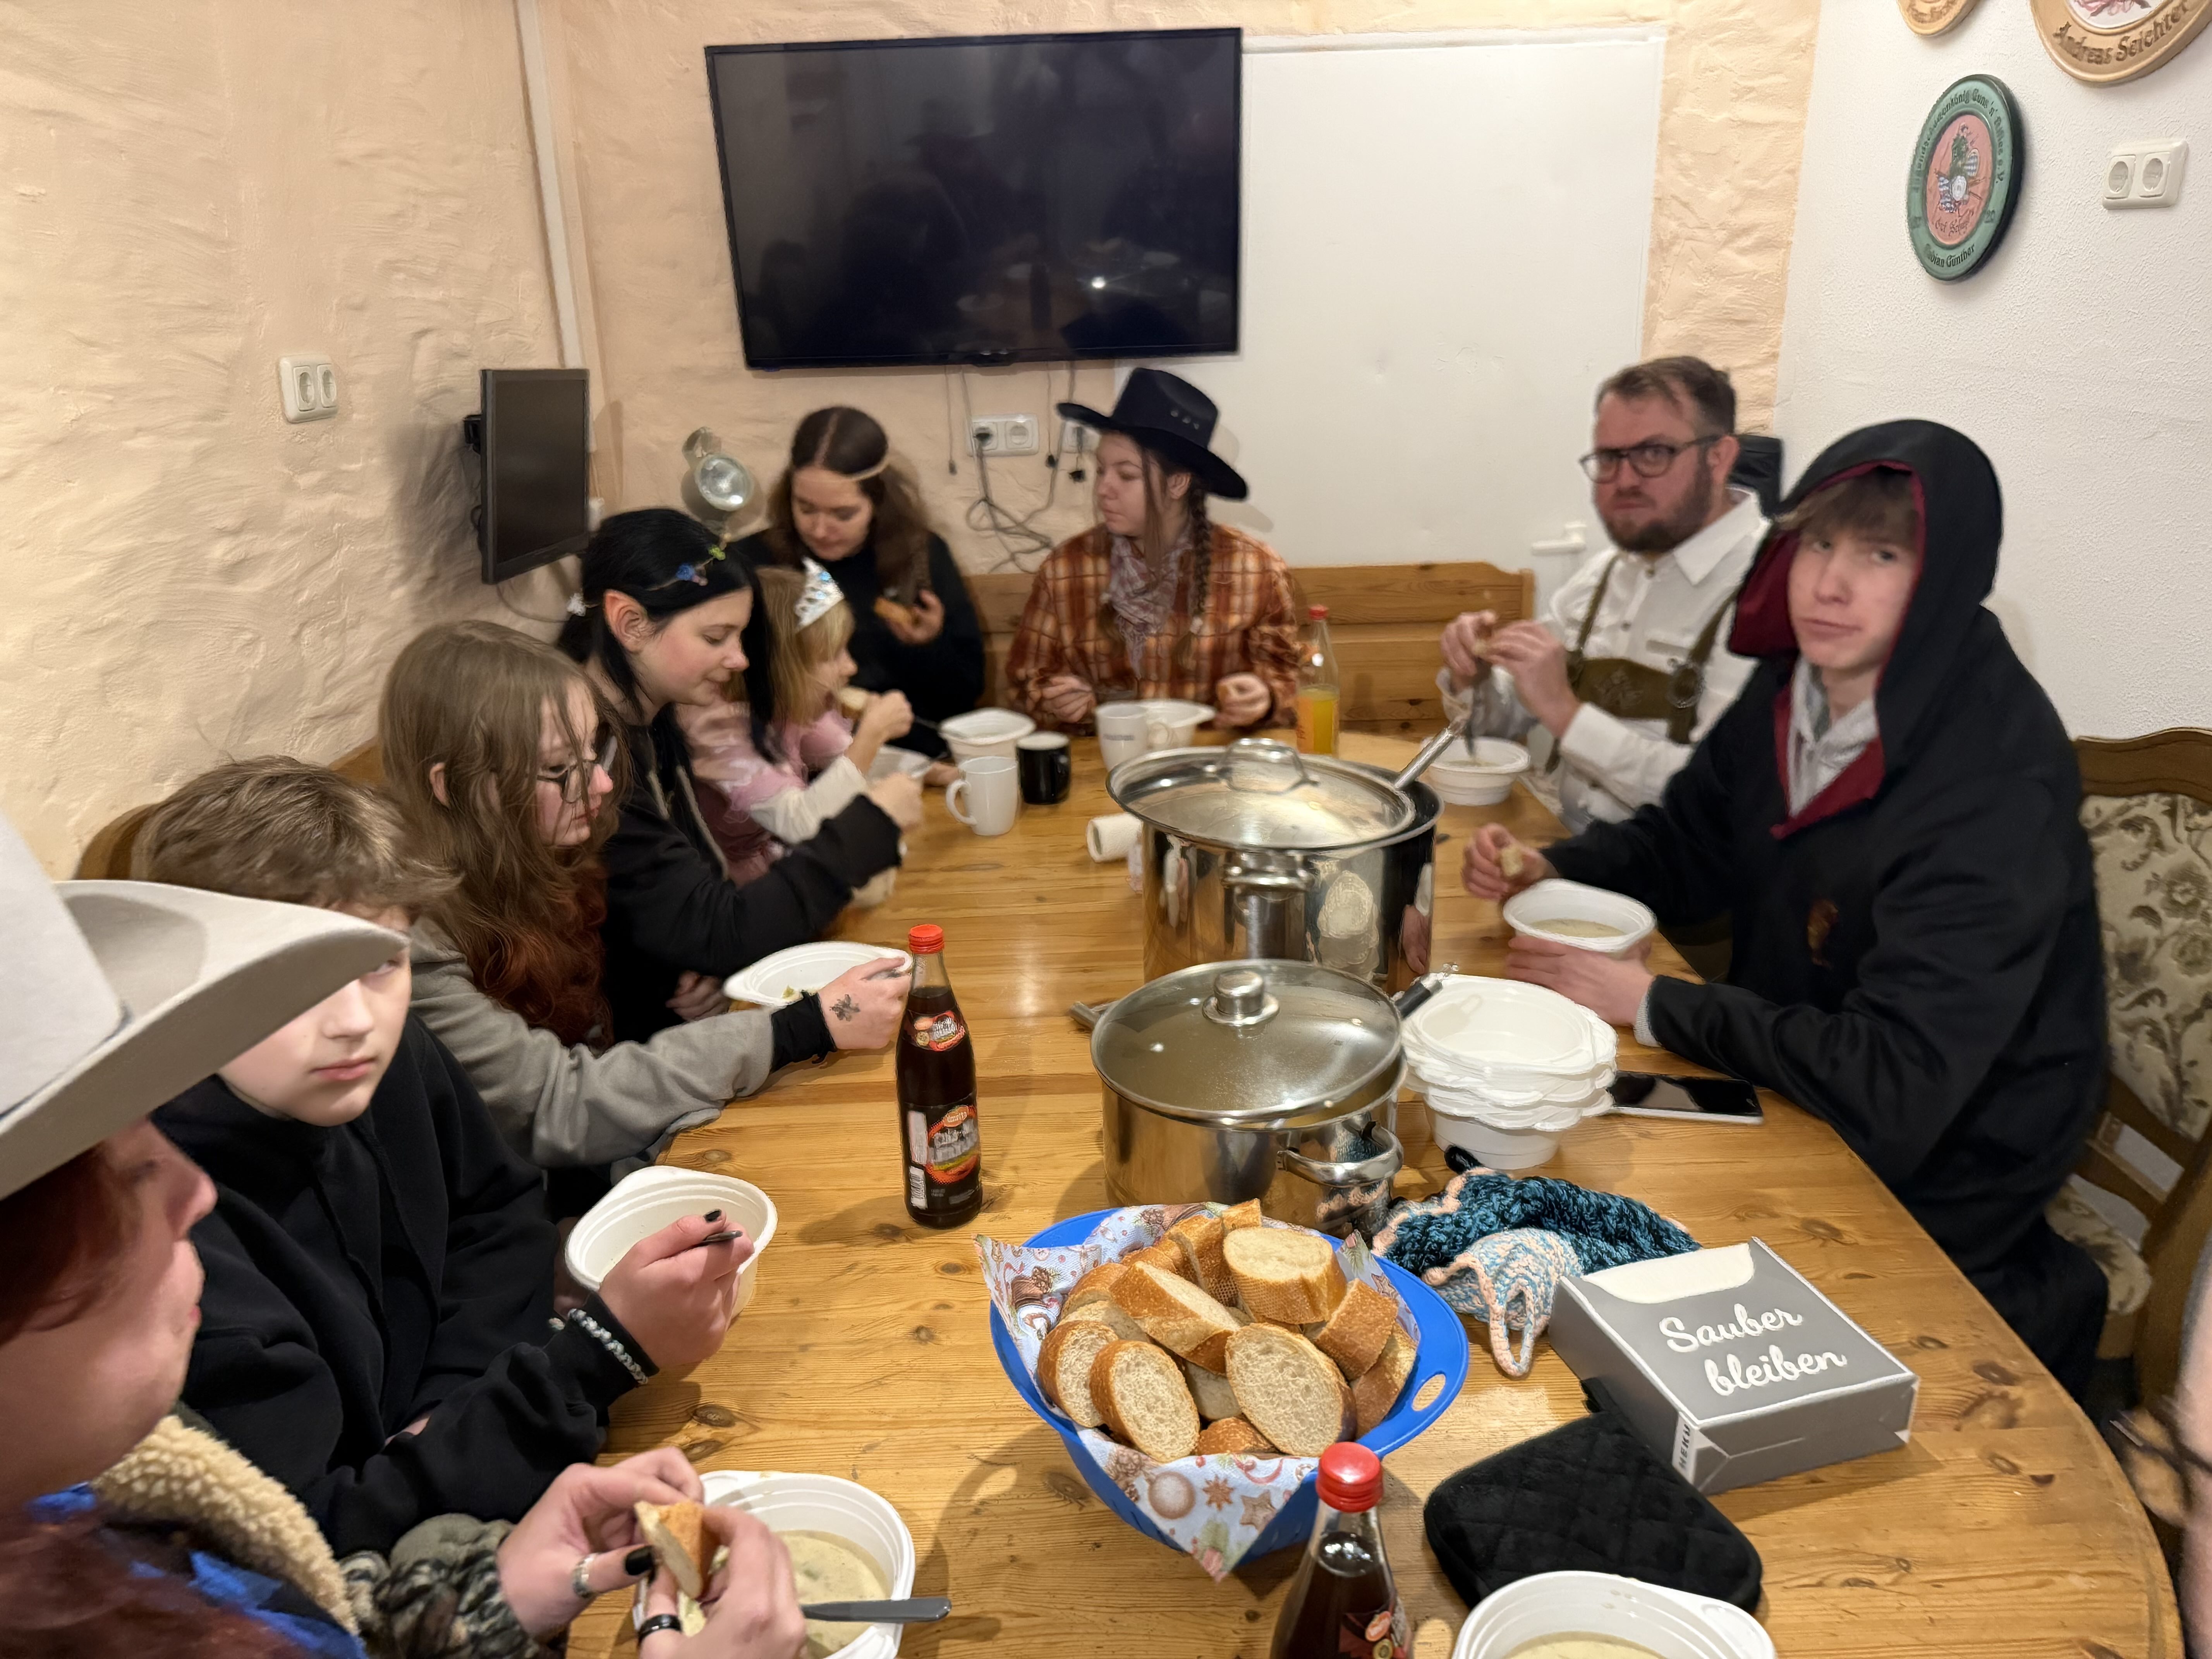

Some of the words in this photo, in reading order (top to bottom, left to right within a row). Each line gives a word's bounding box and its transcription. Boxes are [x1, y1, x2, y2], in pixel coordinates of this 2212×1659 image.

[1972, 88, 1989, 108] Guns
[1660, 1303, 1803, 1353] Sauber
[1704, 1344, 1848, 1396] bleiben
